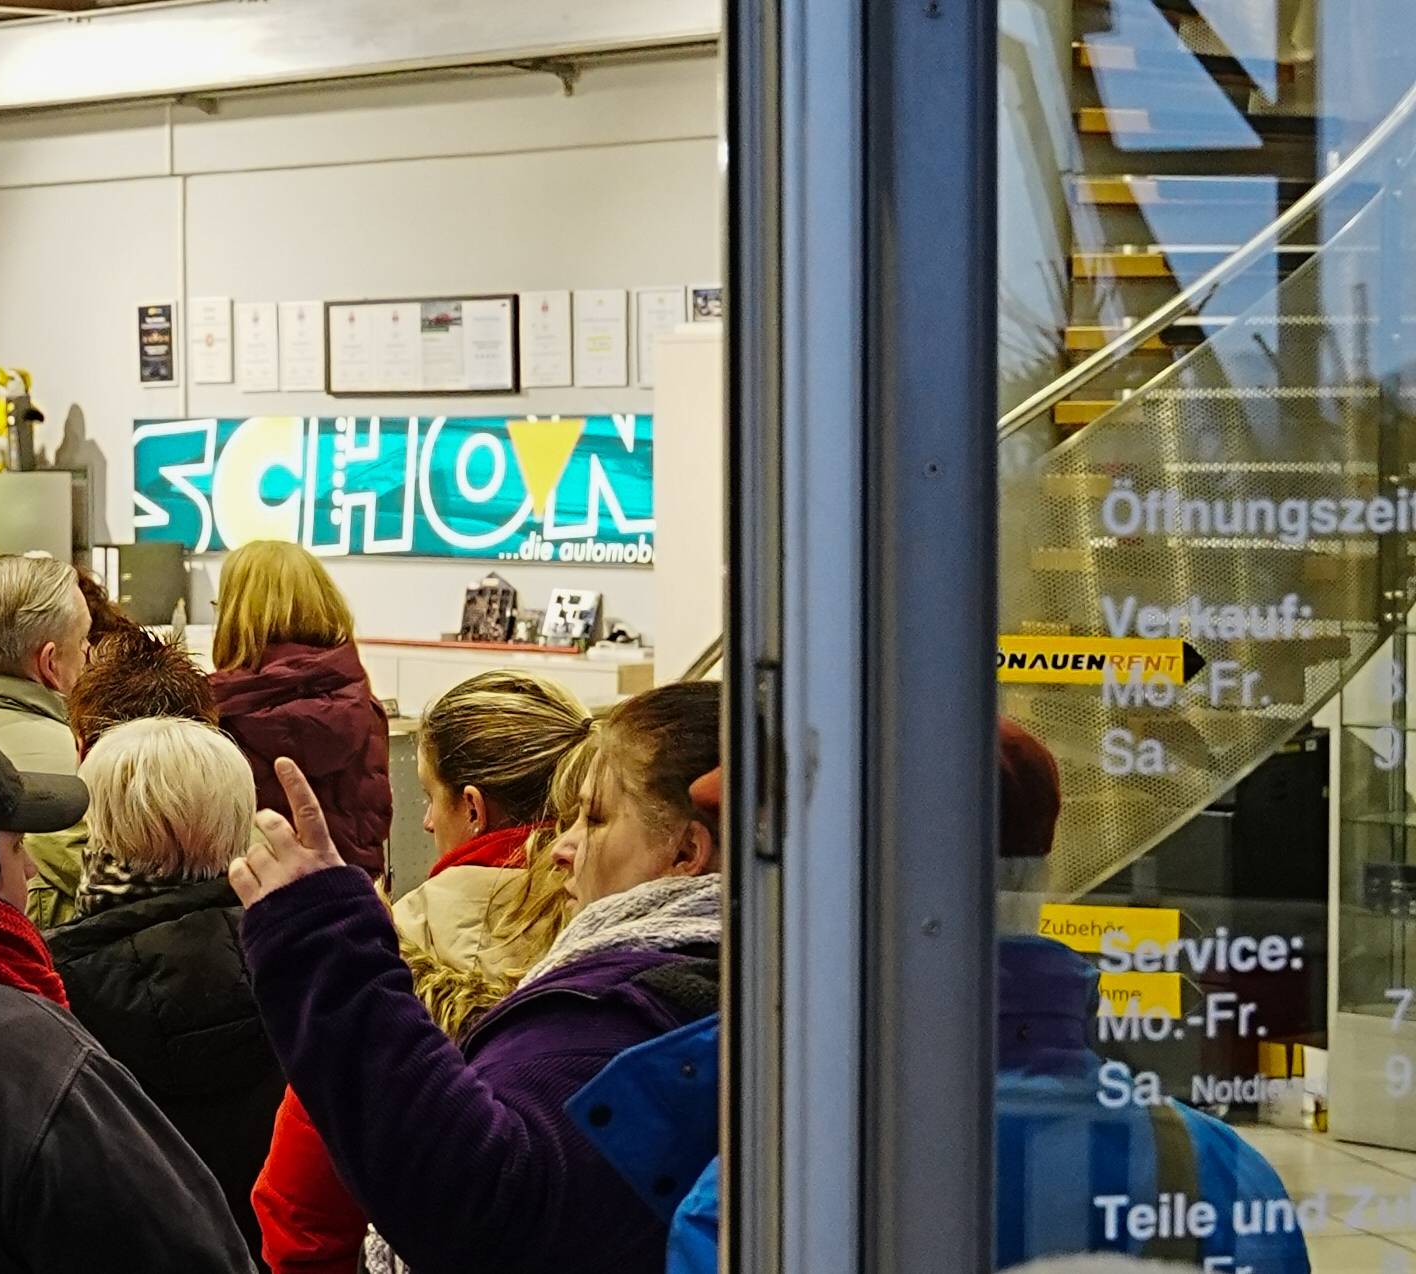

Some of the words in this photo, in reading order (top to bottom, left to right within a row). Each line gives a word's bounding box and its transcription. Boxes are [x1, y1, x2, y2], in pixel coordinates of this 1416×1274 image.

[1102, 477, 1416, 544] Öffnungszei
[558, 533, 654, 563] automob
[1100, 593, 1313, 639] Verkauf:
[1100, 726, 1178, 775] Sa.
[1040, 919, 1124, 937] Zubehör
[1099, 926, 1304, 975] Service:
[1099, 984, 1143, 1004] hme
[1384, 988, 1413, 1033] 7
[1096, 1059, 1174, 1107] Sa.
[1191, 1073, 1319, 1104] Notdie
[1385, 1054, 1413, 1099] 9
[1093, 1192, 1218, 1241] Teile
[1232, 1189, 1327, 1234] und
[1345, 1185, 1416, 1226] Zu
